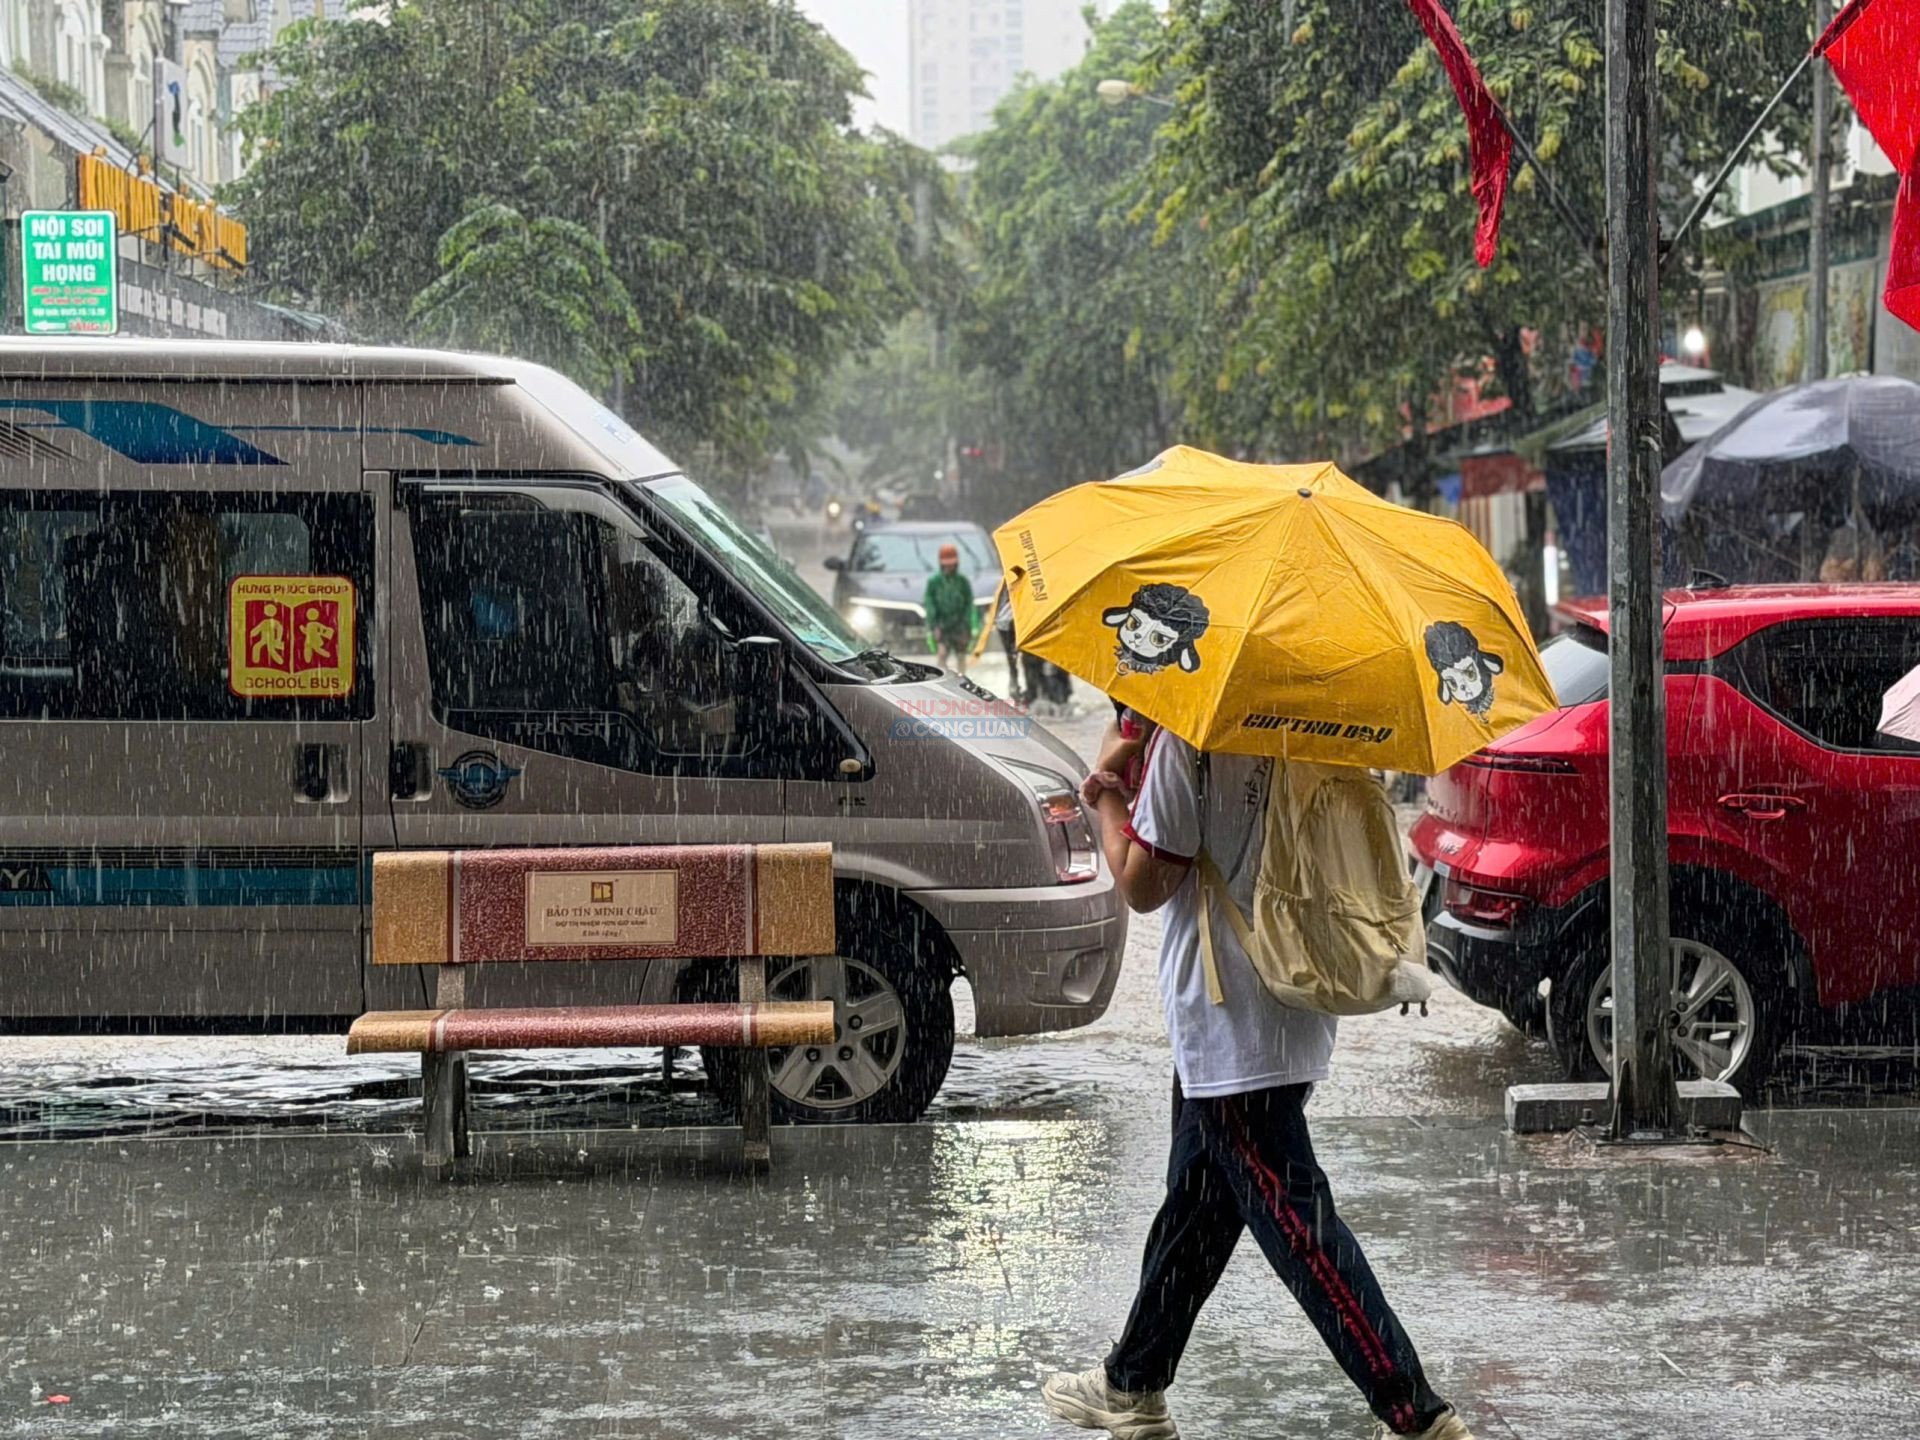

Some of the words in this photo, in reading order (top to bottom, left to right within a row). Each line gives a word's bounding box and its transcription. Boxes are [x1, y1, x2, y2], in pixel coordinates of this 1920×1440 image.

[31, 215, 66, 240] NỘI
[71, 218, 104, 237] SOI
[32, 241, 61, 260] TAI
[66, 239, 104, 260] MŨI
[42, 264, 97, 285] HỌNG
[308, 584, 349, 595] GROUP
[245, 677, 306, 689] SCHOOL
[310, 677, 340, 689] BUS
[510, 722, 618, 737] TRANSIT
[1241, 713, 1343, 737] CAPTAIN
[546, 904, 569, 917] BẢO
[571, 906, 591, 917] TÍN
[594, 907, 623, 917] MINH
[626, 904, 657, 917] CHÂU
